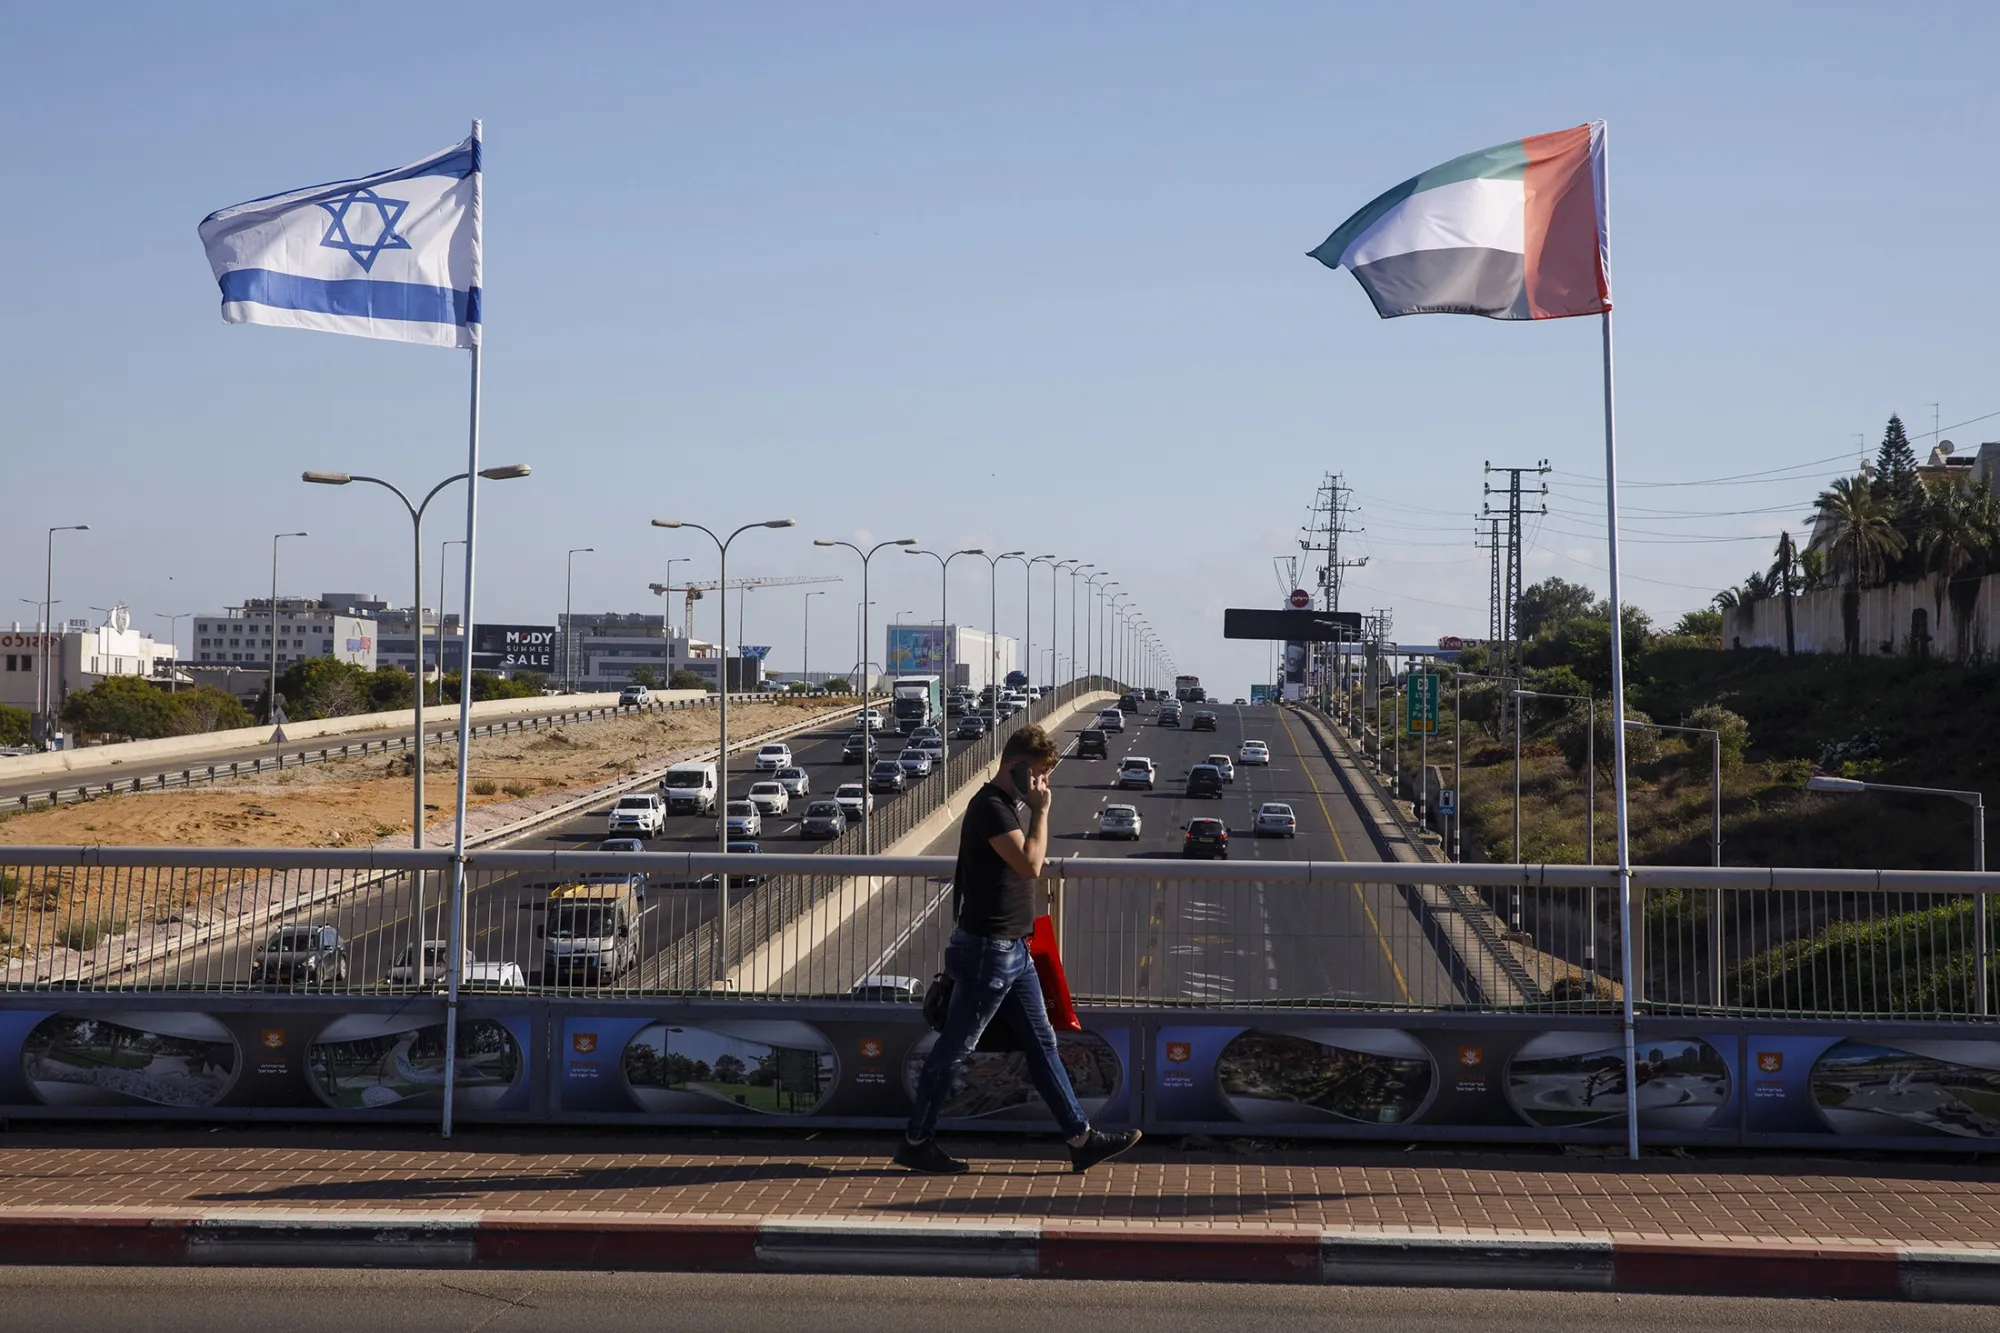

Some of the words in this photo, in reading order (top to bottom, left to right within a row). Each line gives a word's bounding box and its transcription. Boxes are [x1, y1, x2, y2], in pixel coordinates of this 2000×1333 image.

[505, 631, 553, 645] MODY
[506, 645, 550, 653] SUMMER
[506, 653, 550, 666] SALE
